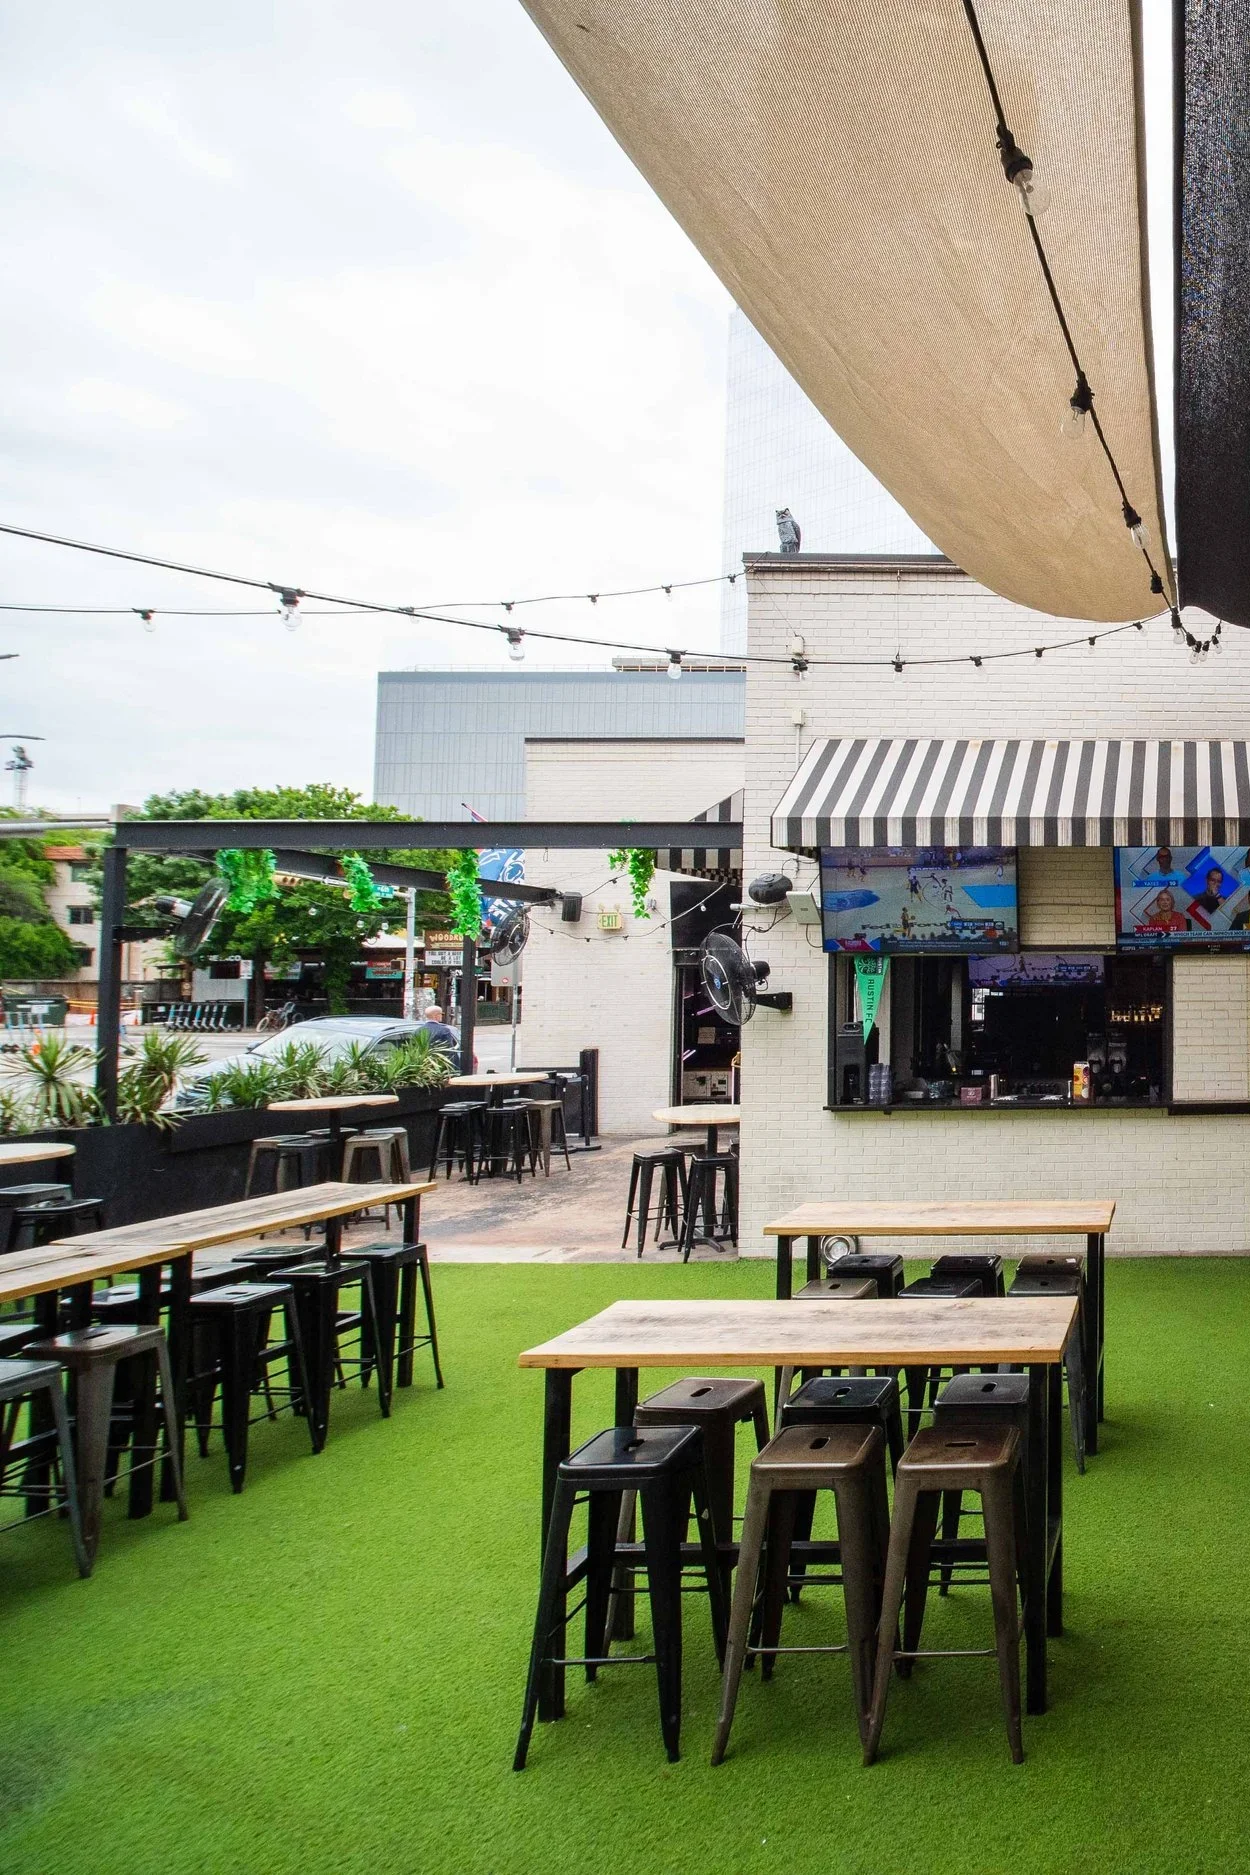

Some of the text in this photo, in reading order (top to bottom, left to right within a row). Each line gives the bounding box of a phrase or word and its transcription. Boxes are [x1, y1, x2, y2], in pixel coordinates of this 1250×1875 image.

[601, 915, 618, 927] EXIT
[865, 979, 875, 1023] AUSTIN FC
